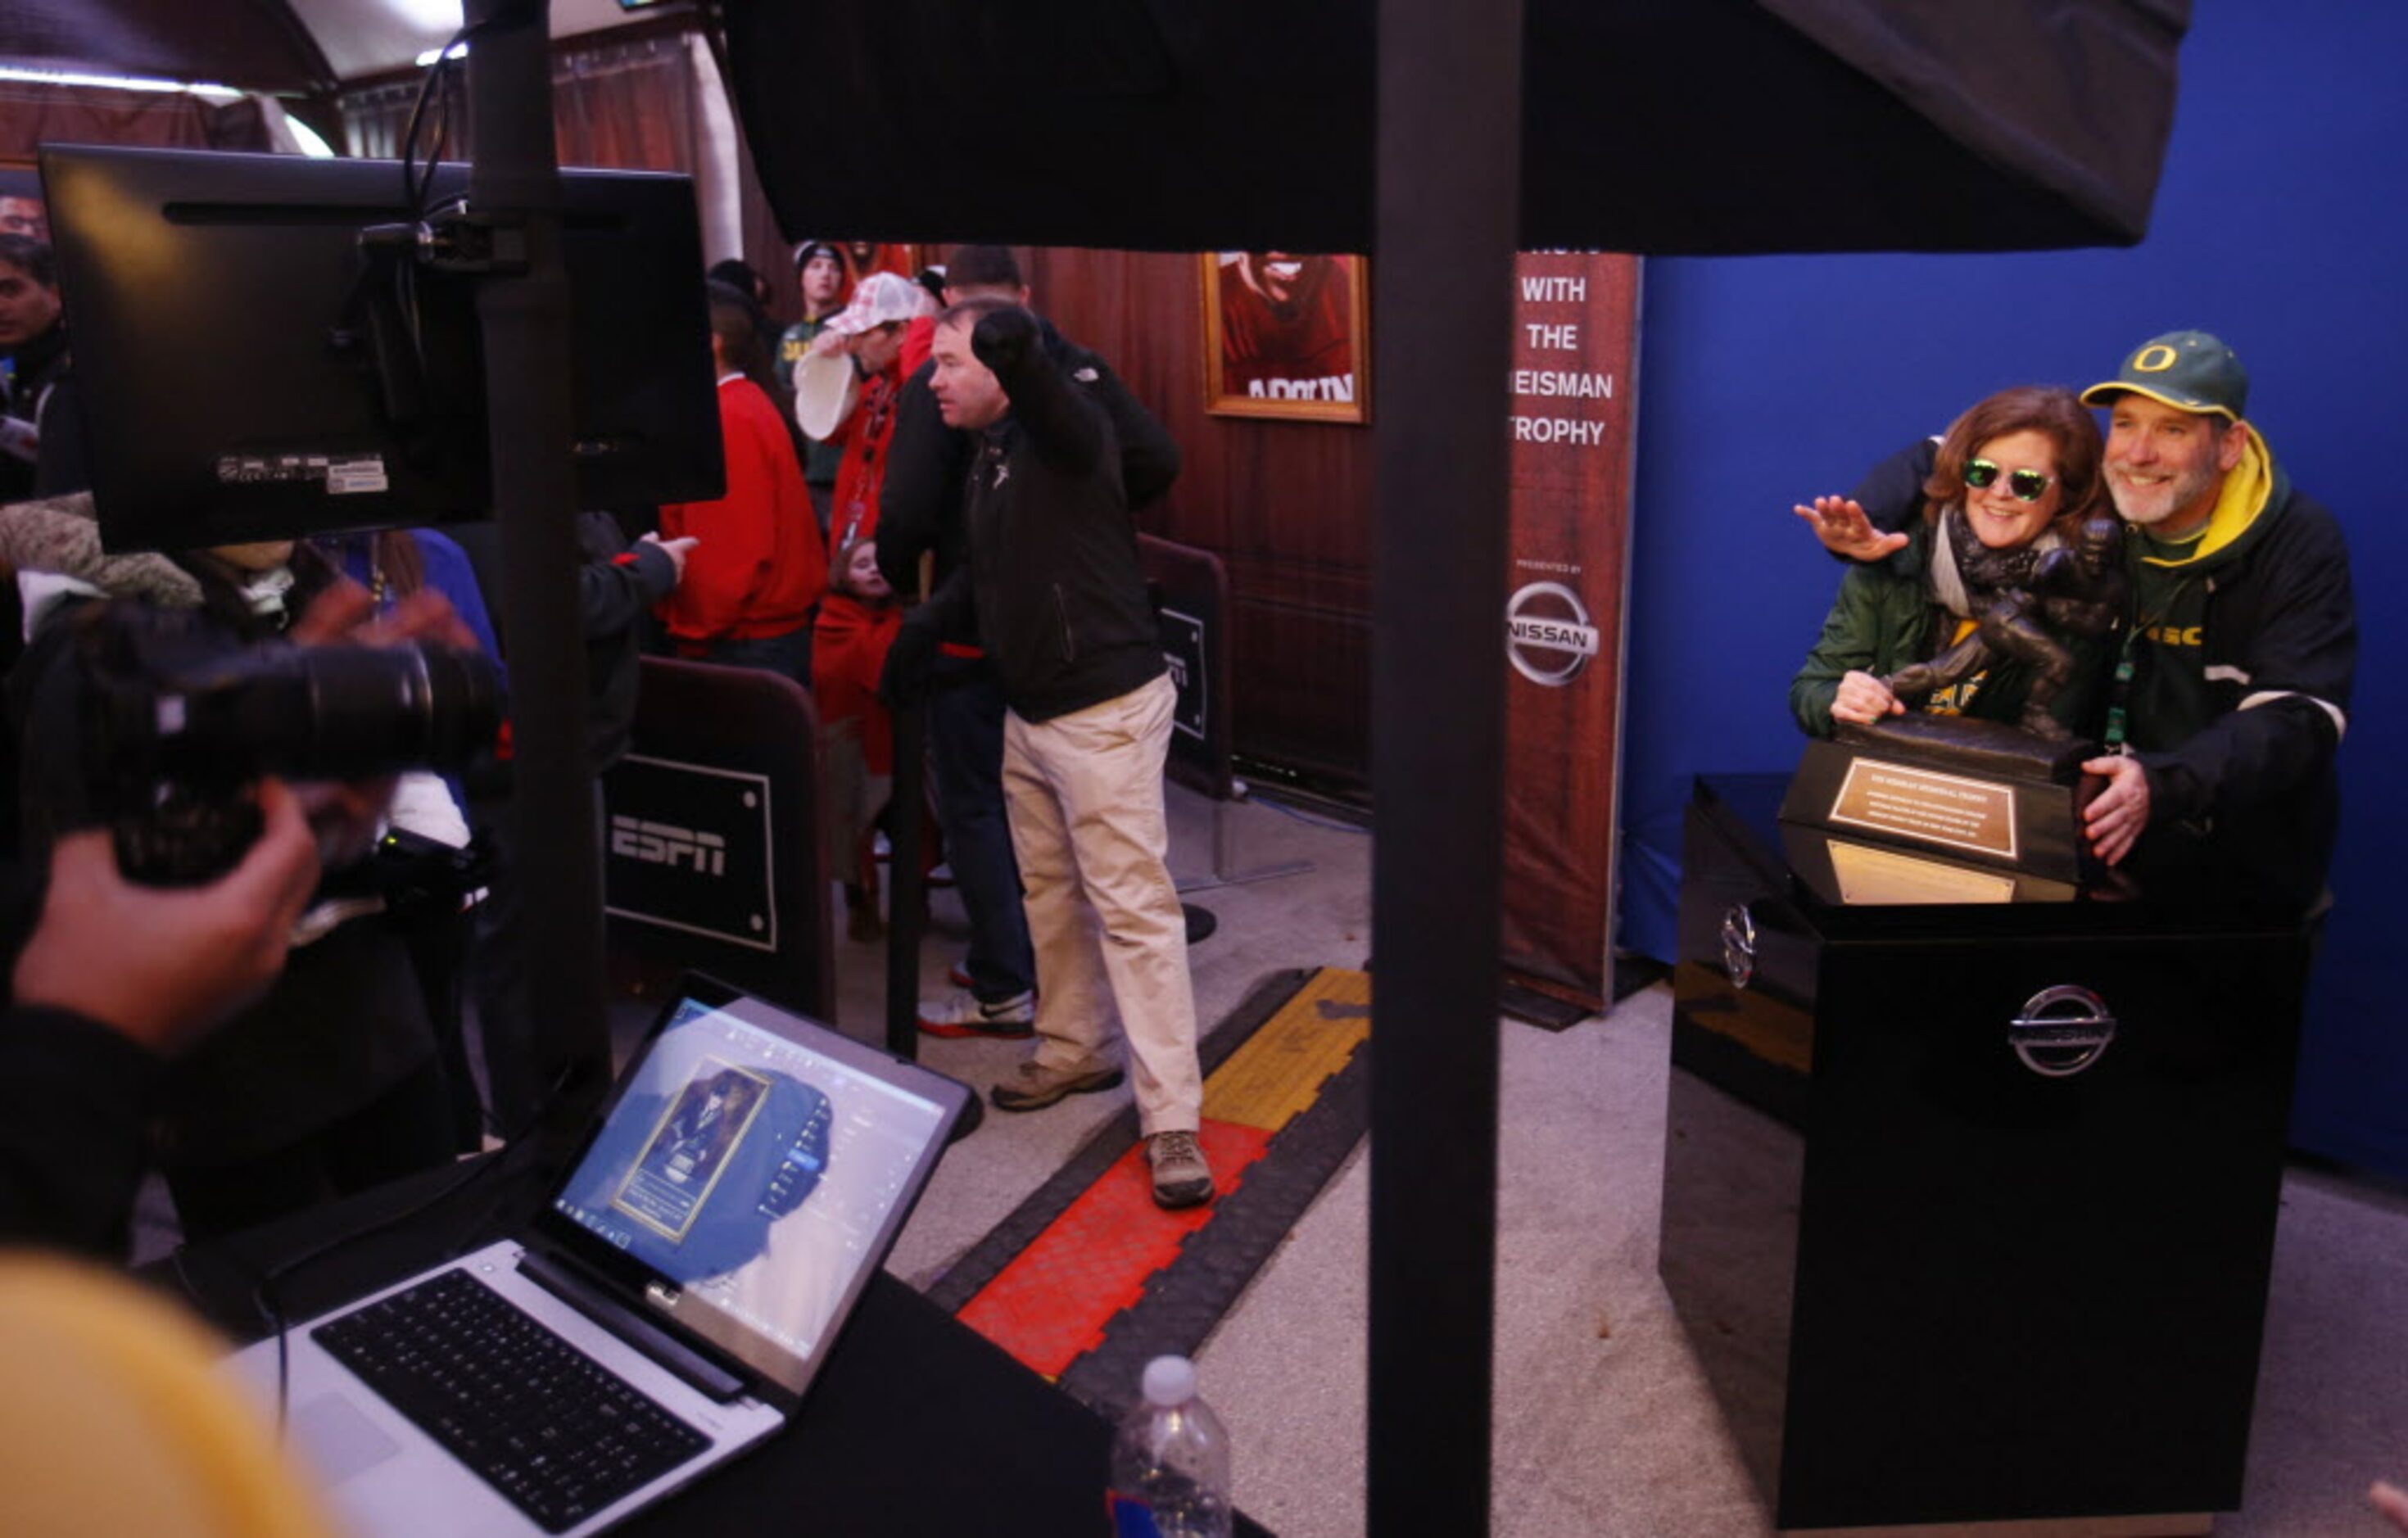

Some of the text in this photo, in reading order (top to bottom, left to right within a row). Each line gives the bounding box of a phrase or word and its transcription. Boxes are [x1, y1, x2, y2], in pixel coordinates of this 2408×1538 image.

[1522, 277, 1586, 301] WITH
[1526, 324, 1578, 350] THE
[2133, 345, 2176, 373] O
[1510, 371, 1613, 398] EISMAN
[1508, 621, 1587, 648] NISSAN
[613, 815, 725, 876] ESPN
